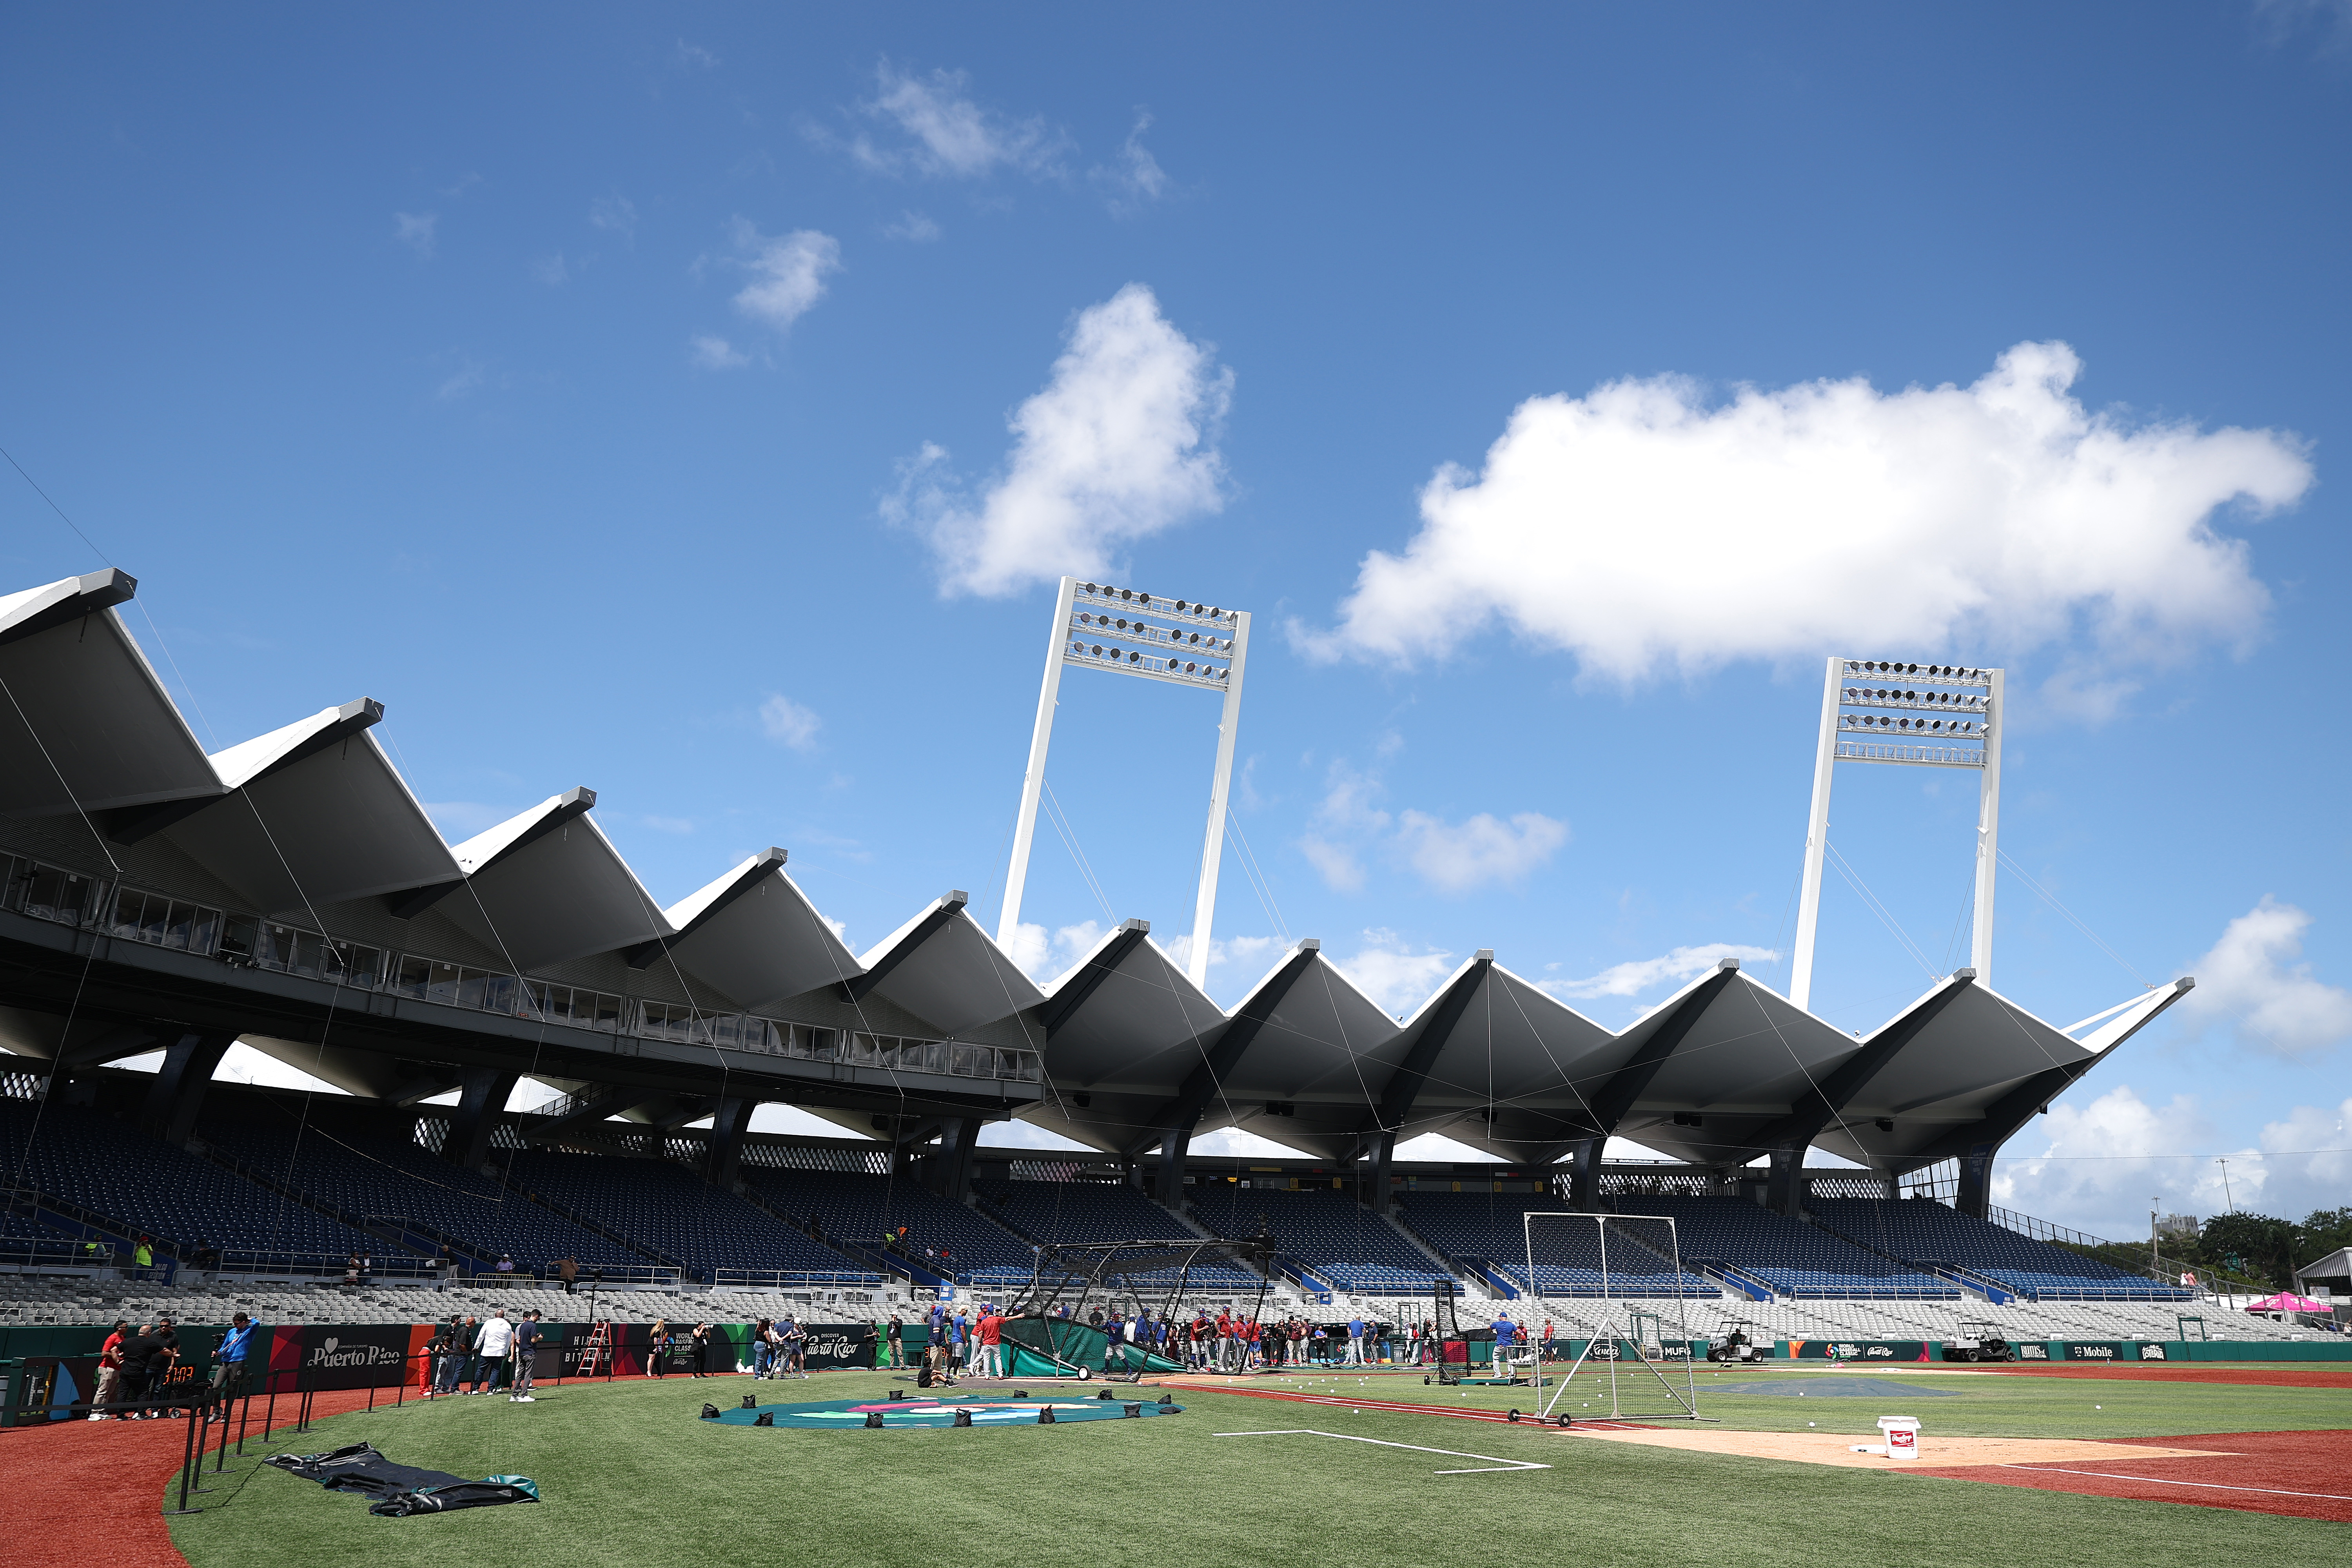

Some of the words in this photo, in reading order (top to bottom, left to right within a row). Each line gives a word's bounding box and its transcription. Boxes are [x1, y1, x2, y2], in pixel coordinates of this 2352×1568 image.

[834, 1336, 858, 1358] Rico
[1665, 1347, 1691, 1356] MUFG
[1881, 1347, 1893, 1357] Rico
[2083, 1347, 2113, 1357] Mobile
[307, 1348, 365, 1367] Puerto
[366, 1346, 400, 1365] Rico
